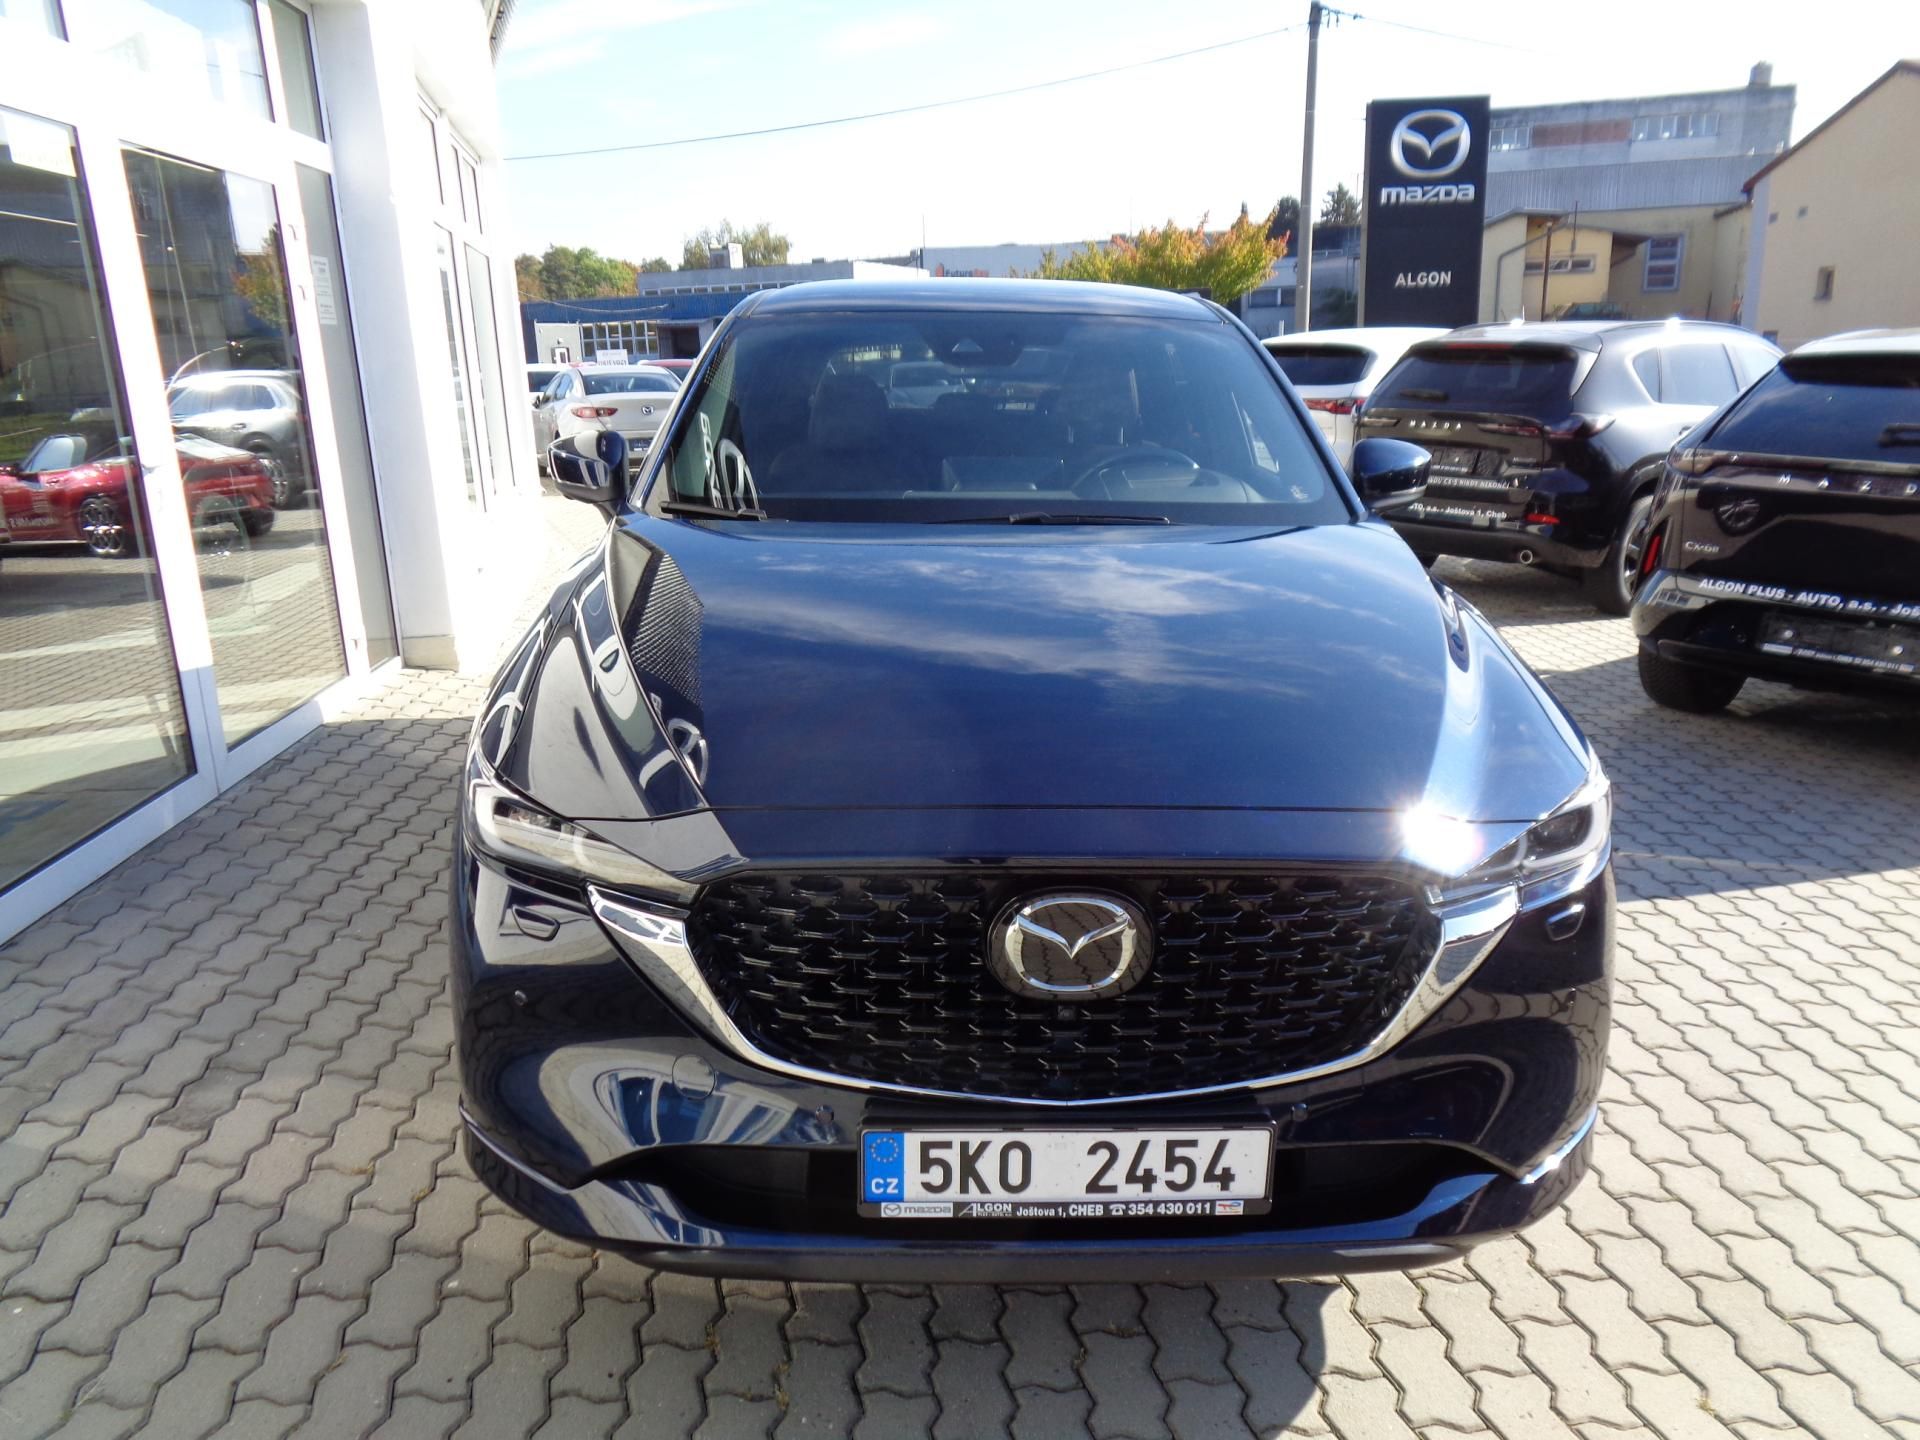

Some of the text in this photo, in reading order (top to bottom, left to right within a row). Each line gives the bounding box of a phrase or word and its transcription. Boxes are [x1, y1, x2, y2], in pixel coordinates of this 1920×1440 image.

[1394, 271, 1451, 287] ALGON
[1409, 419, 1462, 429] MAZDA
[1486, 510, 1507, 519] Cheb
[1699, 578, 1746, 593] ALGON
[1747, 584, 1786, 600] PLUS
[1796, 592, 1844, 611] AUTO,
[1085, 1138, 1236, 1194] 2454
[871, 1178, 899, 1194] CZ
[959, 1202, 1012, 1217] ALGON
[1017, 1206, 1056, 1217] Joštova
[1058, 1205, 1067, 1218] 1,
[1069, 1204, 1104, 1216] CHEB
[1128, 1203, 1153, 1215] 354
[1157, 1203, 1183, 1215] 430
[1186, 1202, 1211, 1214] 011
